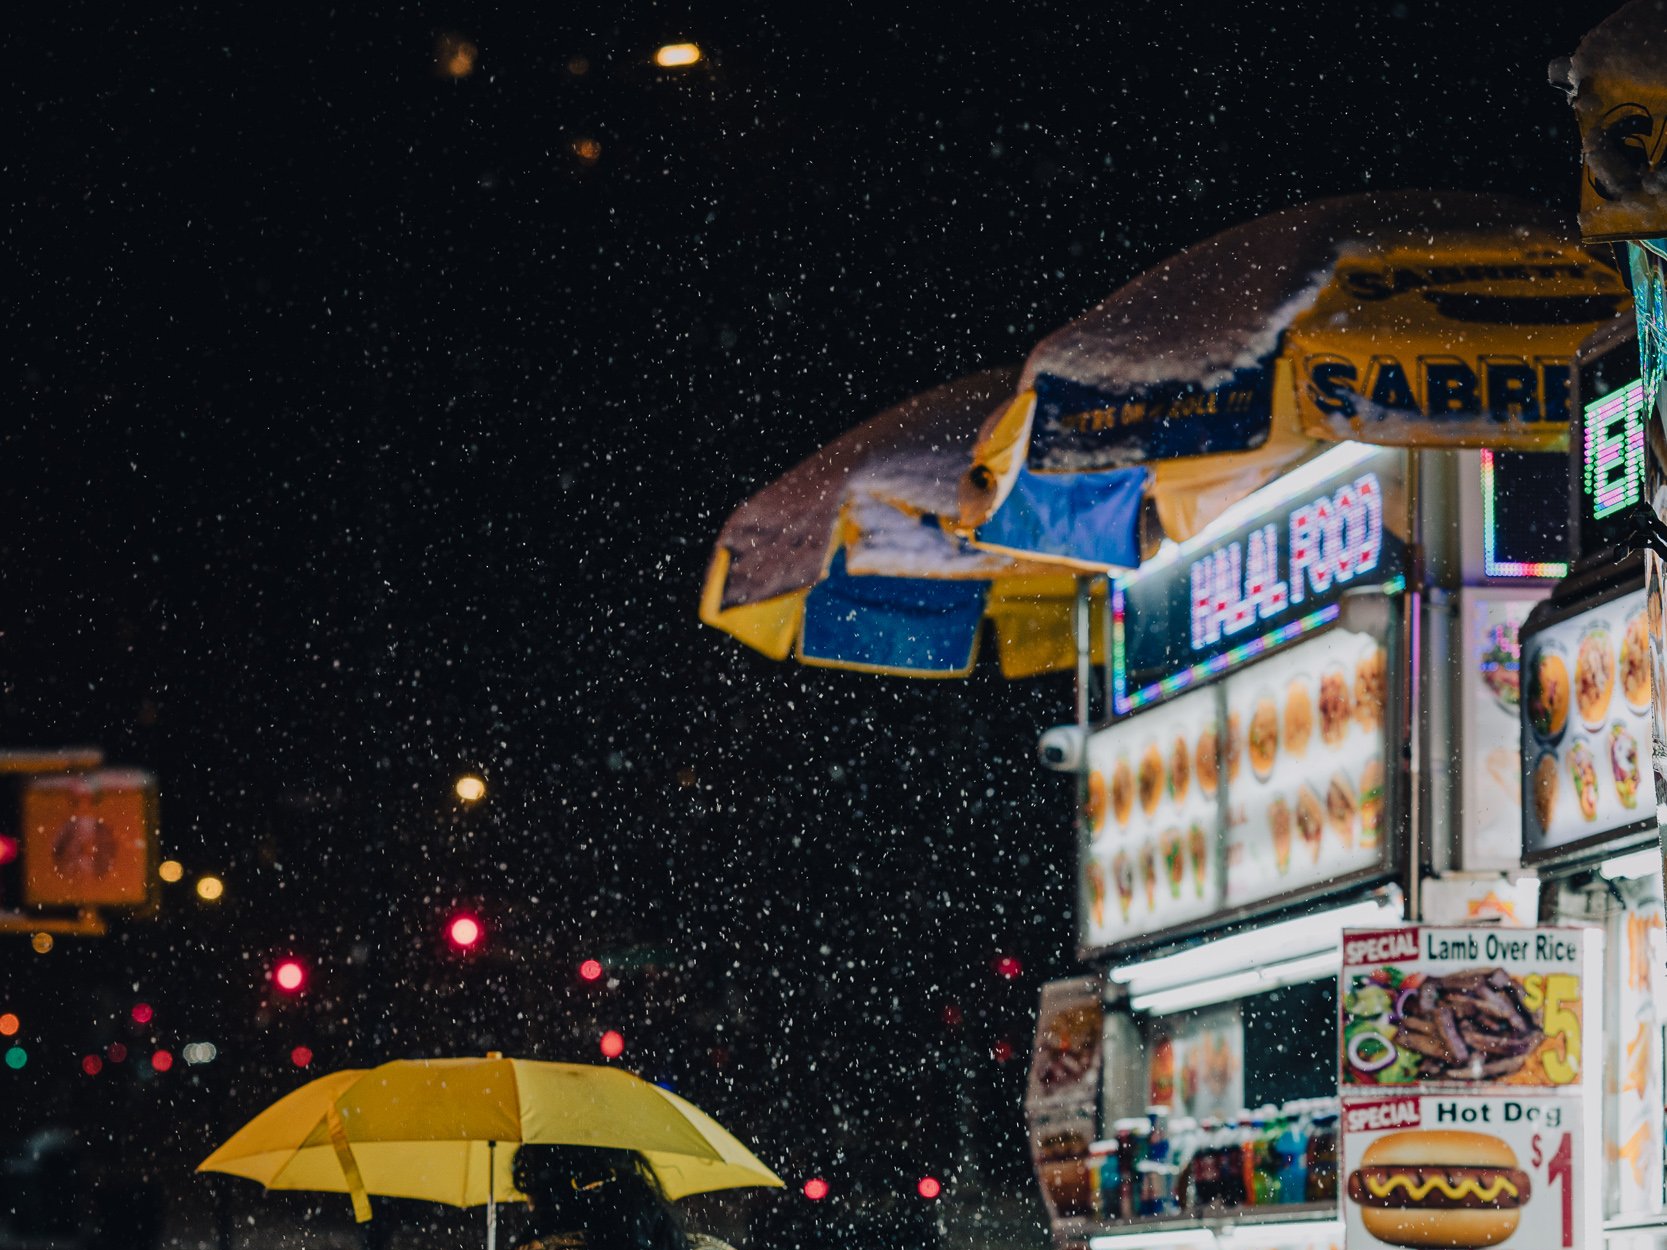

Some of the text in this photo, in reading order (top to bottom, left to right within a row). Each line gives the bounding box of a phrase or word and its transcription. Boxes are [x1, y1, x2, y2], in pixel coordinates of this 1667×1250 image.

[1190, 471, 1383, 650] HALAL FOOD
[1344, 932, 1419, 964] SPECIAL
[1427, 932, 1577, 961] Lamb Over Rice
[1347, 1100, 1419, 1131] SPECIAL
[1437, 1102, 1562, 1128] Hot Dog
